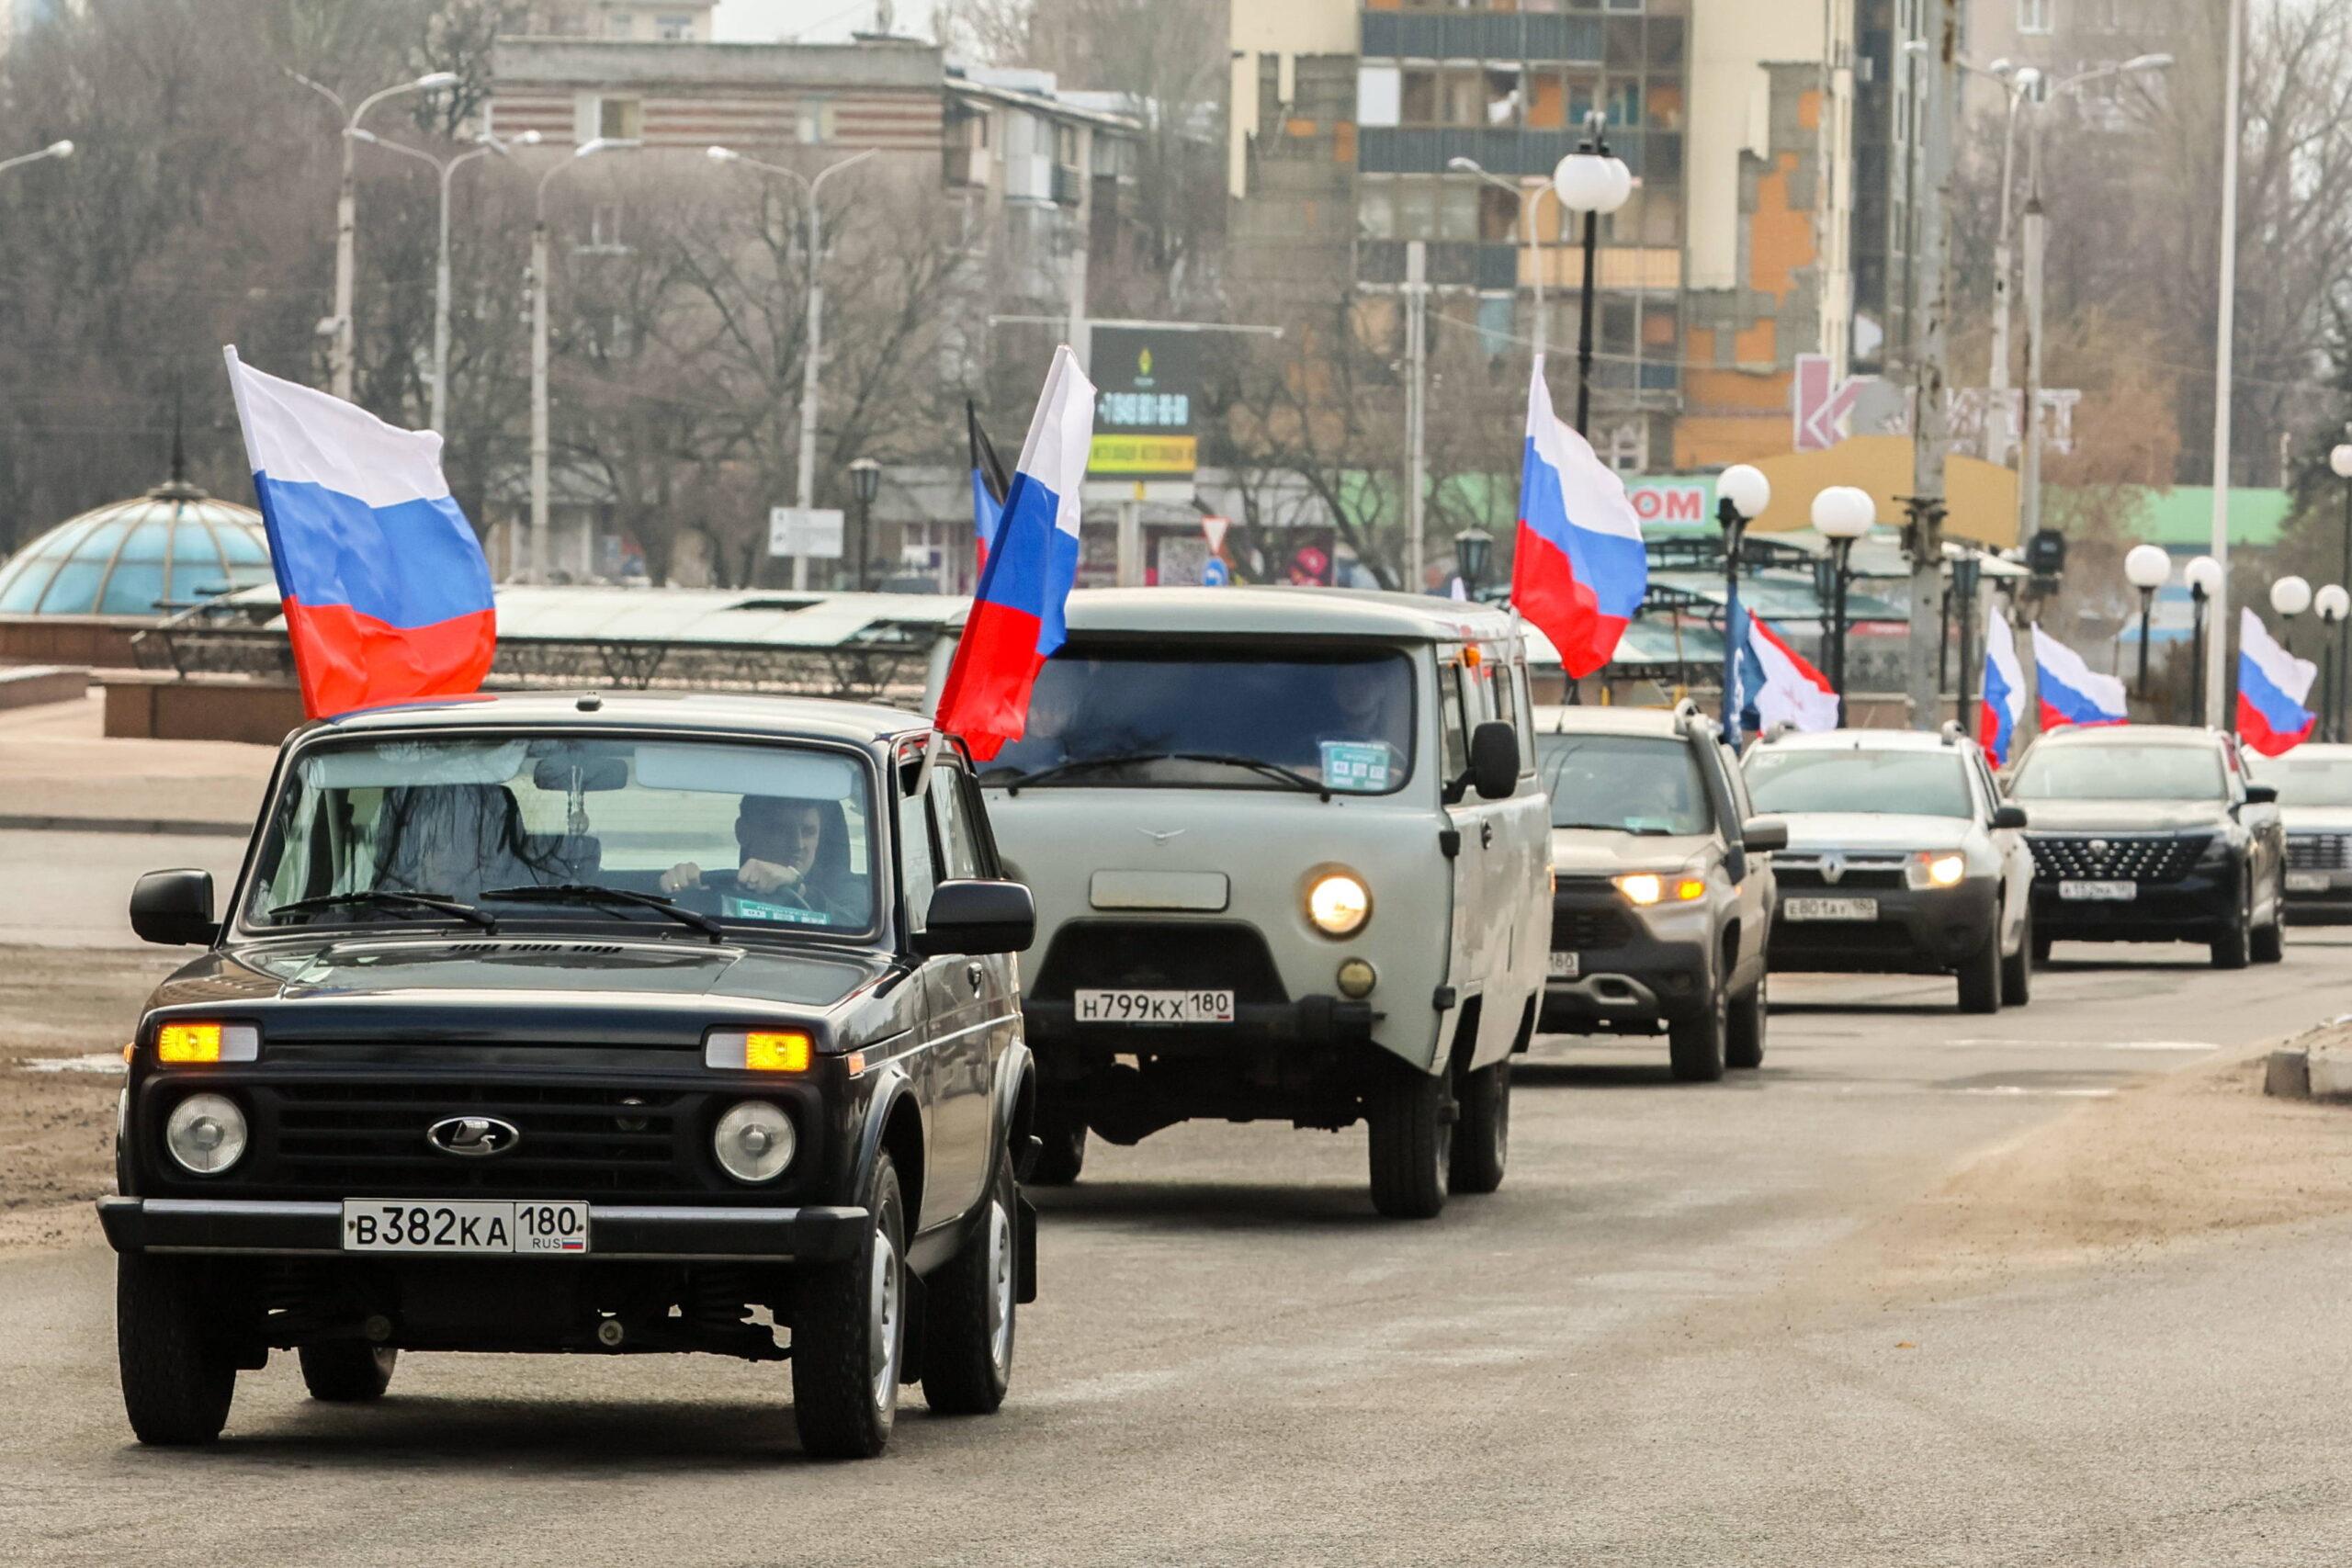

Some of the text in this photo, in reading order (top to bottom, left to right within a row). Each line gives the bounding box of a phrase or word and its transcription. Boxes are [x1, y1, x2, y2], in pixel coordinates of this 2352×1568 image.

[1632, 490, 1702, 520] ОМ
[1083, 993, 1228, 1019] Н799КХ 180
[356, 1206, 577, 1247] В382КА 180
[532, 1237, 561, 1249] RUS
